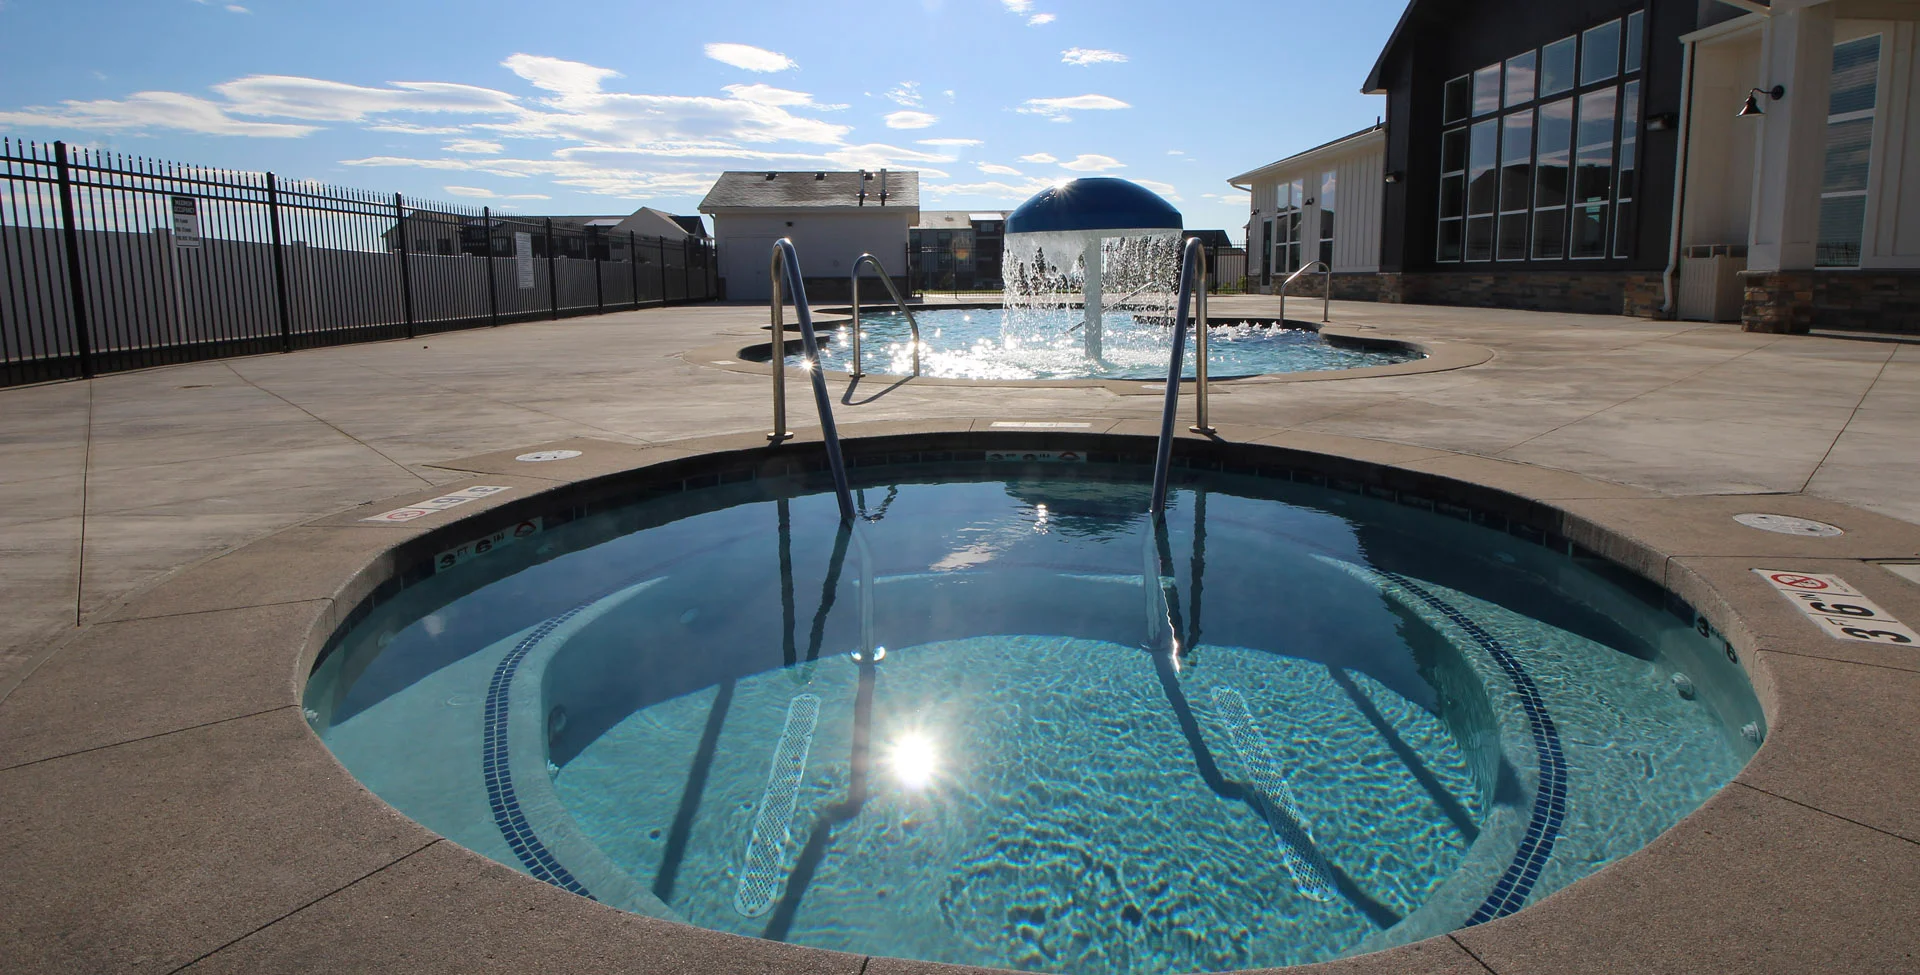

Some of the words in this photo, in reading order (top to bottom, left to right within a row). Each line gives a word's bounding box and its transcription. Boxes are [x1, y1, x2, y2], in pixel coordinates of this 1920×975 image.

[440, 552, 455, 569] 3
[456, 546, 468, 557] FT
[474, 539, 493, 554] 6
[1809, 602, 1875, 617] 6
[1841, 627, 1912, 643] 3
[1725, 641, 1738, 664] 6
